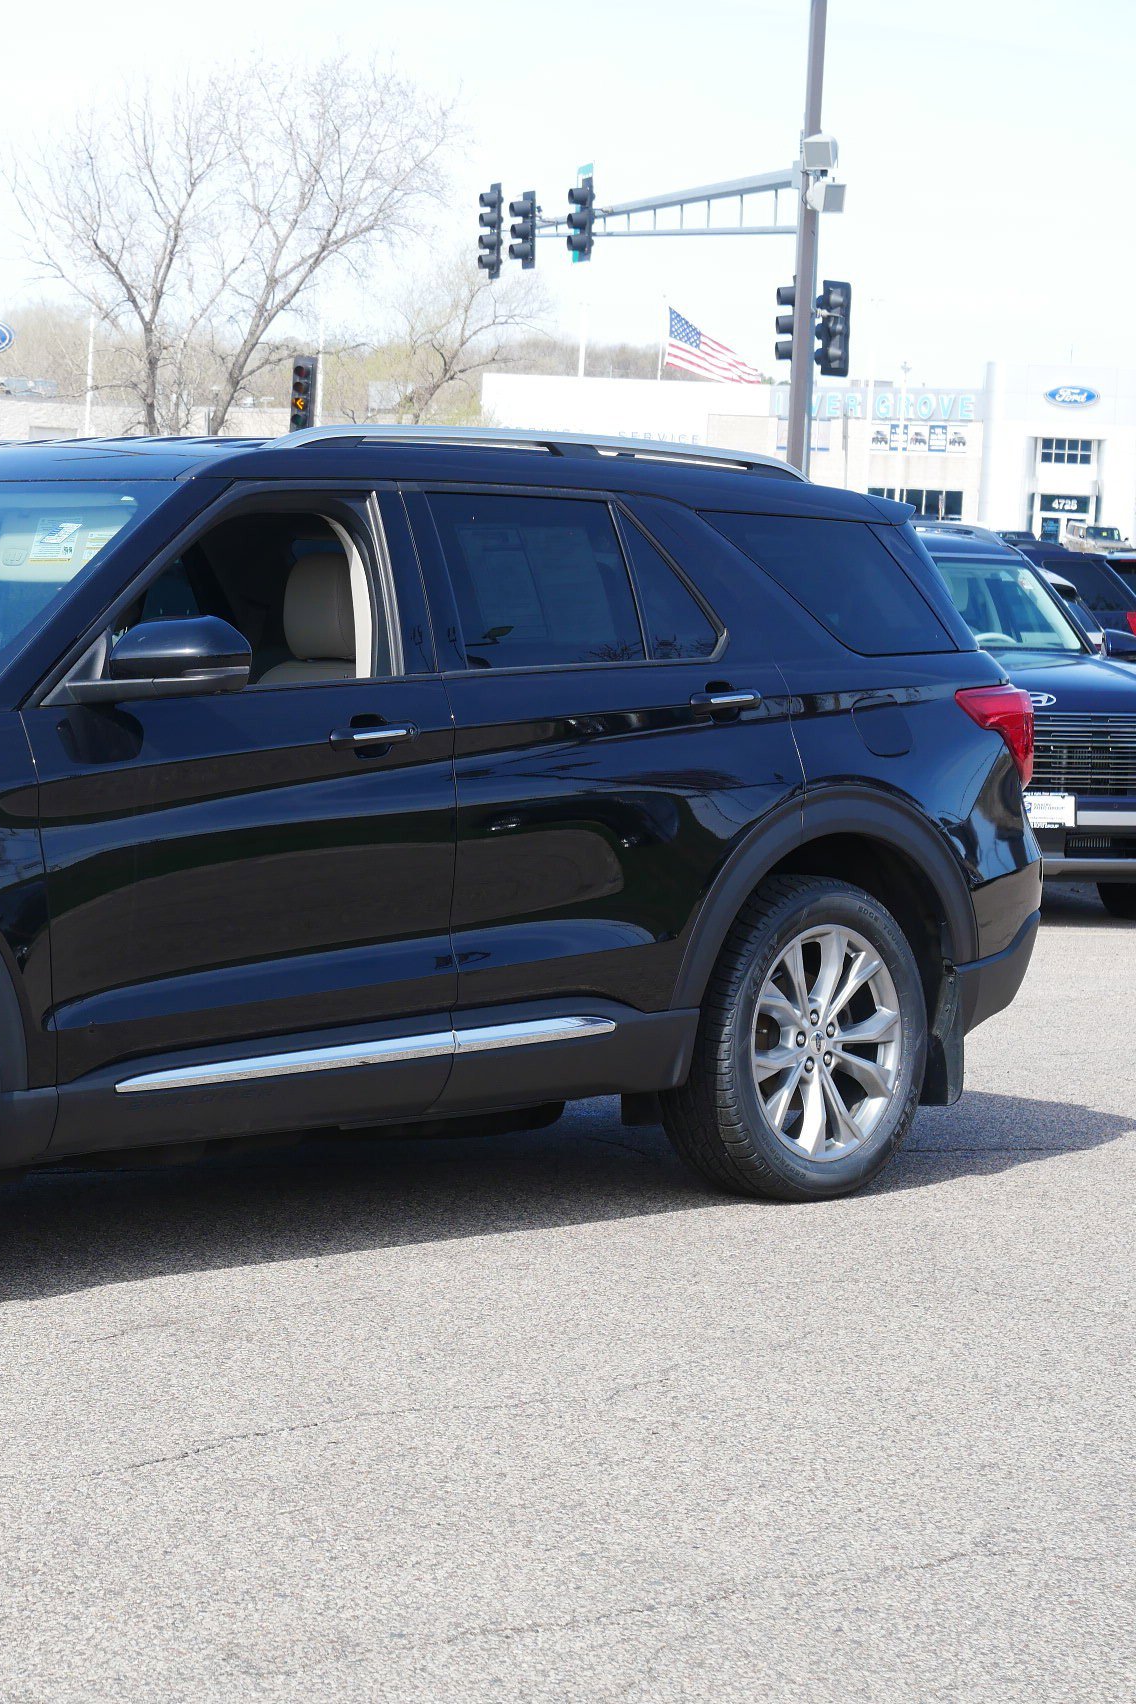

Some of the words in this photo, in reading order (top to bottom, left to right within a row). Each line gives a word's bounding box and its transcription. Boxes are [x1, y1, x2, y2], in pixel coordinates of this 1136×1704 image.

[776, 391, 862, 417] IVER
[875, 393, 975, 419] GROVE
[1055, 388, 1087, 403] Ford
